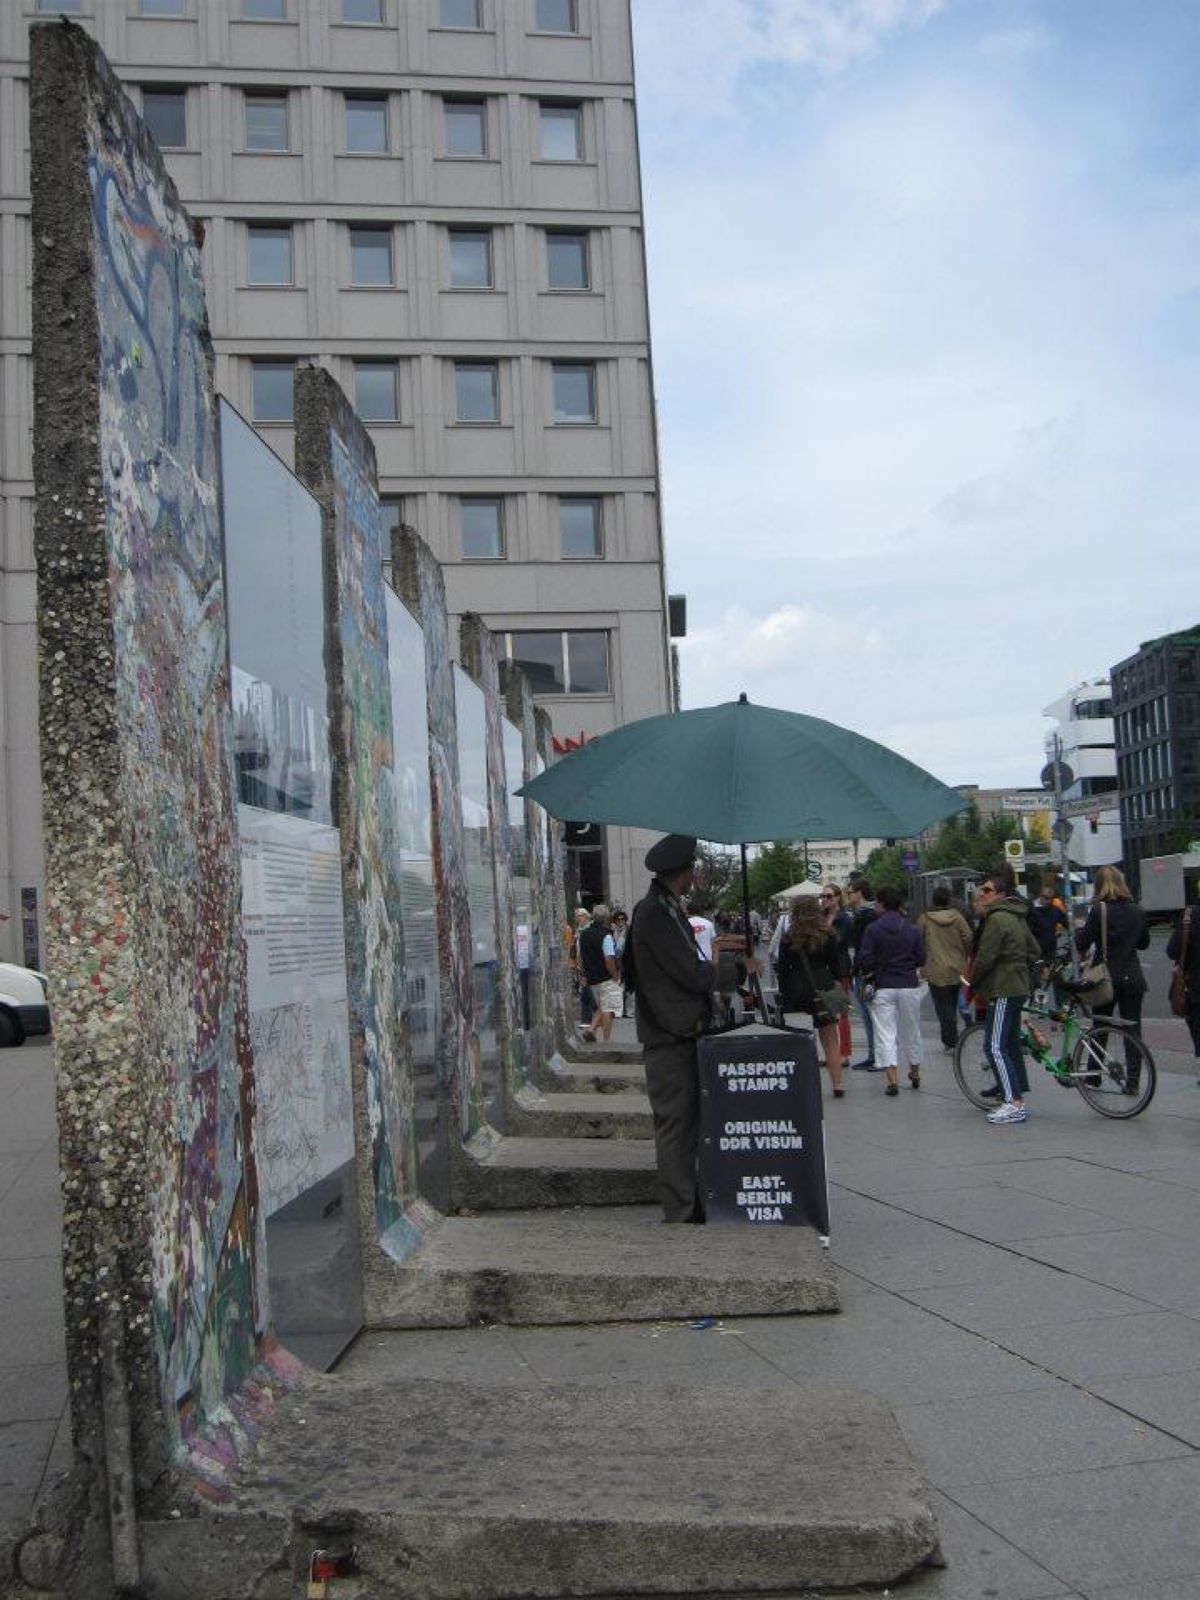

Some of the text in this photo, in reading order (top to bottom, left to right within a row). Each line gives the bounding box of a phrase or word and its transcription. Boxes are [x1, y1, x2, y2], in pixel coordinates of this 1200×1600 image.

[808, 862, 821, 876] S
[717, 1061, 796, 1077] PASSPORT
[727, 1077, 789, 1092] STAMPS
[724, 1120, 797, 1135] ORIGINAL
[719, 1135, 803, 1151] DDR VISUM
[742, 1175, 786, 1190] EAST-
[736, 1191, 793, 1206] BERLIN
[746, 1206, 784, 1222] VISA
